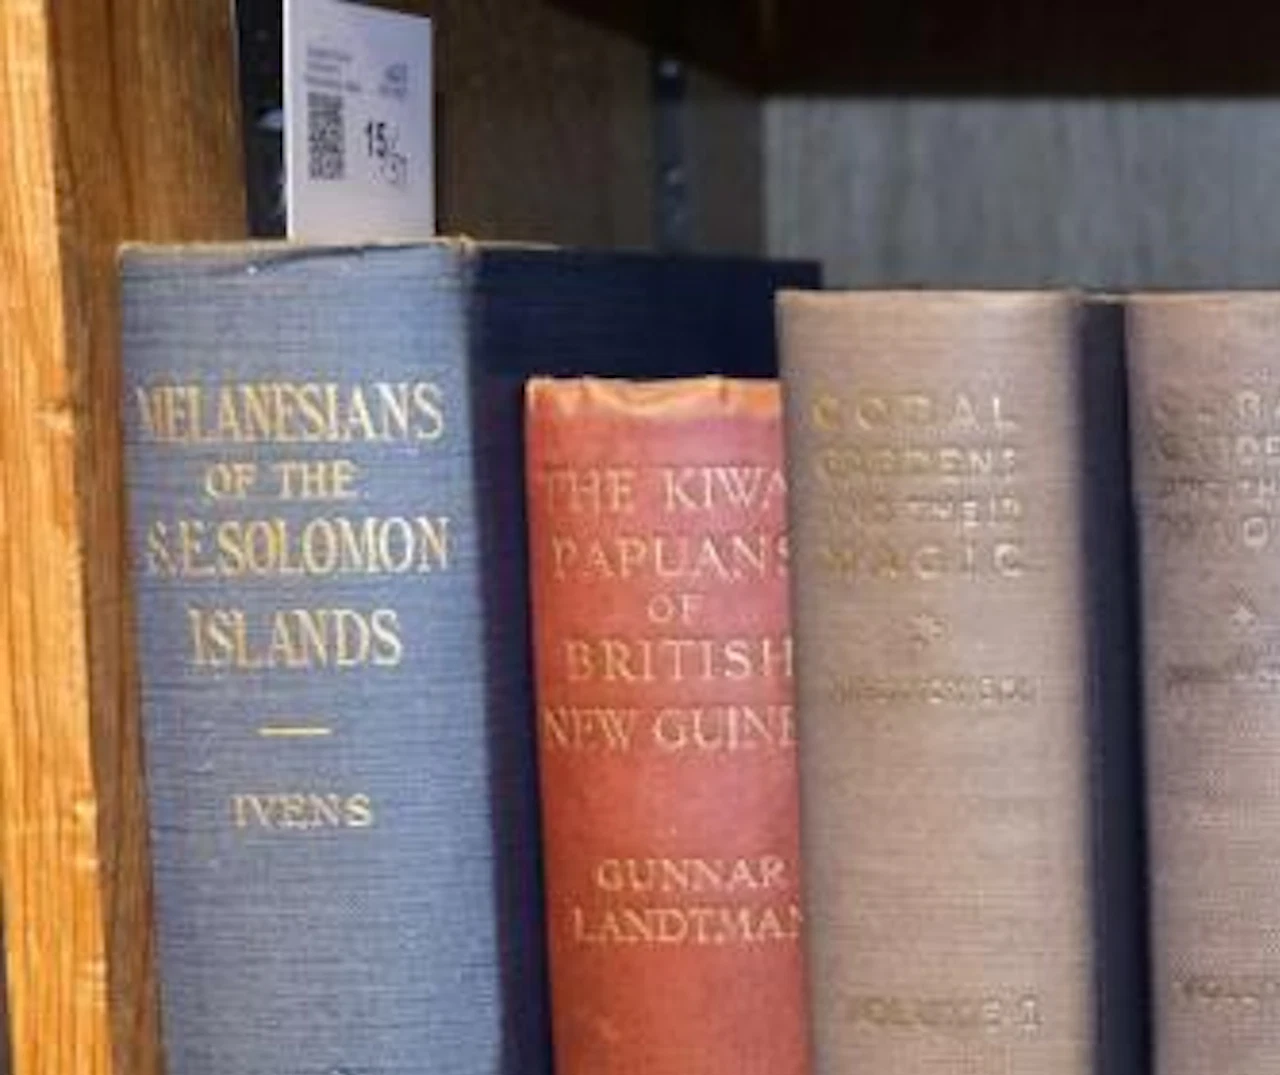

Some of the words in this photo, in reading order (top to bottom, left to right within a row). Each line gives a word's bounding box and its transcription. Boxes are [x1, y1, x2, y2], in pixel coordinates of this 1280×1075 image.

[137, 382, 445, 443] MELANESIANS
[205, 461, 259, 500] OF
[275, 459, 360, 499] THE
[545, 467, 637, 513] THE
[661, 466, 788, 512] KIWA
[646, 593, 704, 625] OF
[188, 606, 404, 668] ISLANDS
[563, 636, 794, 682] BRITISH
[543, 706, 637, 751] NEW
[233, 793, 374, 828] IVENS
[597, 856, 786, 892] GUNNAR
